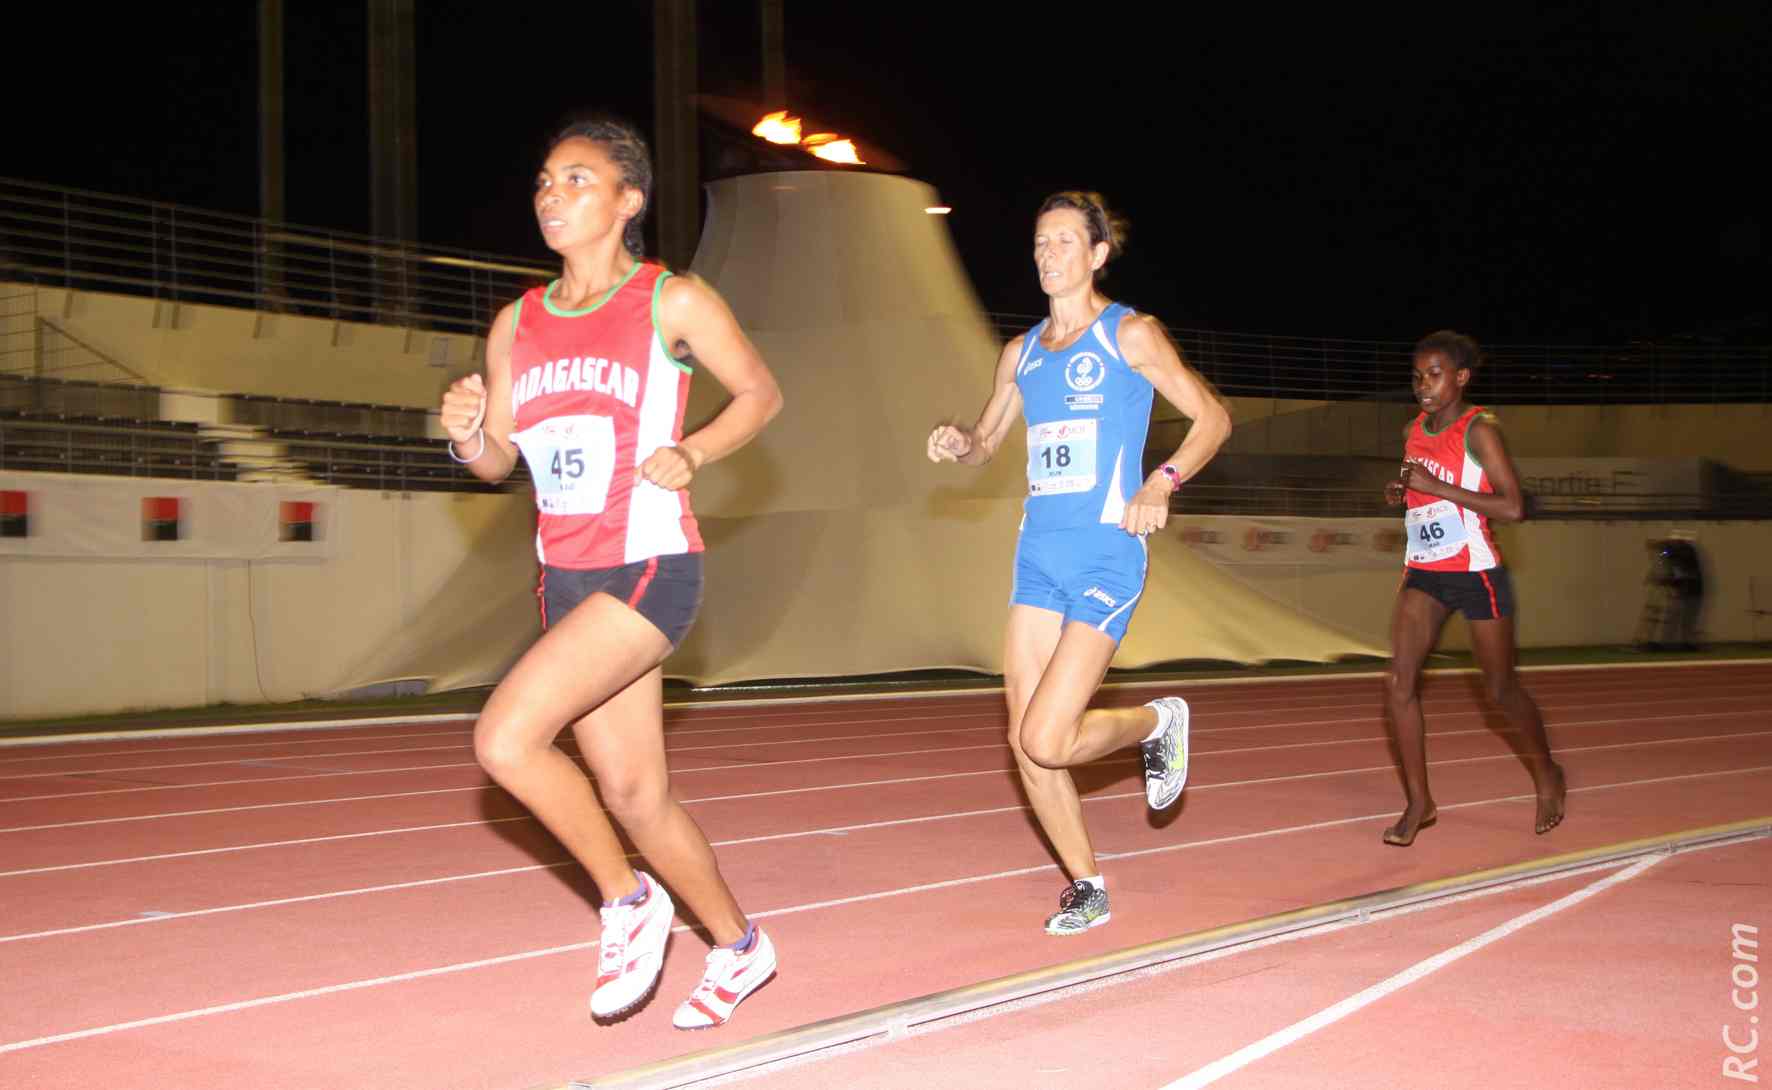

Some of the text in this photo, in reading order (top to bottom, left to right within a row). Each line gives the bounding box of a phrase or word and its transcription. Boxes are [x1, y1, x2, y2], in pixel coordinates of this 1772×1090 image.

[551, 448, 586, 480] 45
[1041, 445, 1072, 469] 18
[1420, 522, 1445, 542] 46
